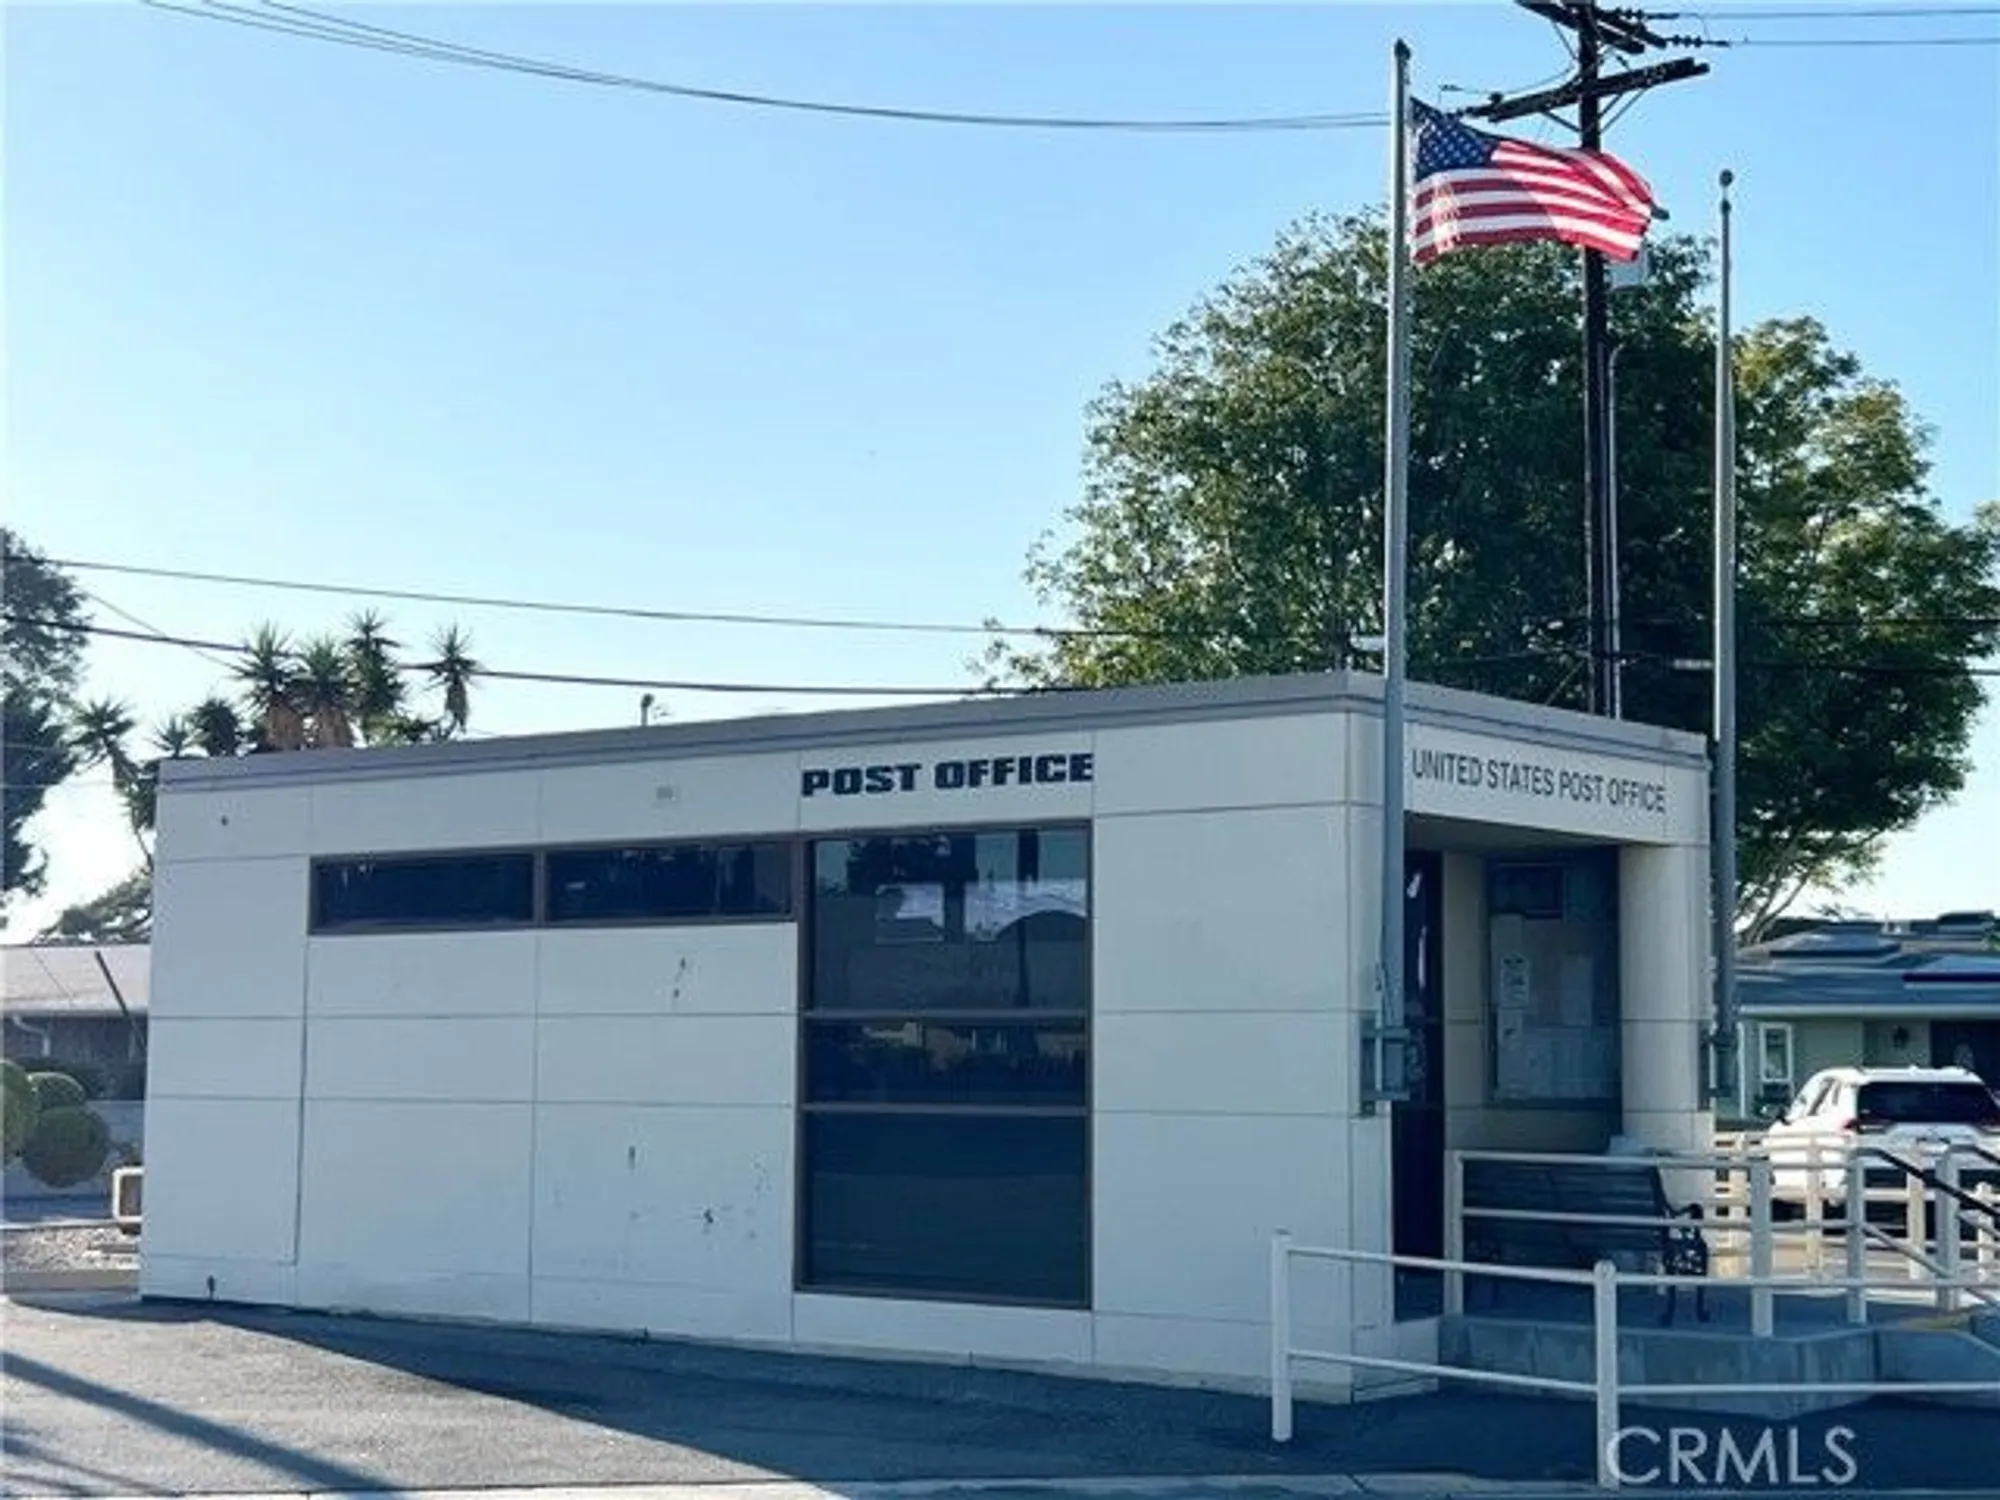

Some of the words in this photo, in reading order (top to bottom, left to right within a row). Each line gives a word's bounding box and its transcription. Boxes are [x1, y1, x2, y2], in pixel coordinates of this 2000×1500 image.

[801, 763, 921, 797] POST
[934, 752, 1095, 789] OFFICE
[1411, 749, 1483, 787] UNITED
[1487, 758, 1554, 796] STATES
[1559, 770, 1603, 804] POST
[1608, 777, 1667, 814] OFFICE
